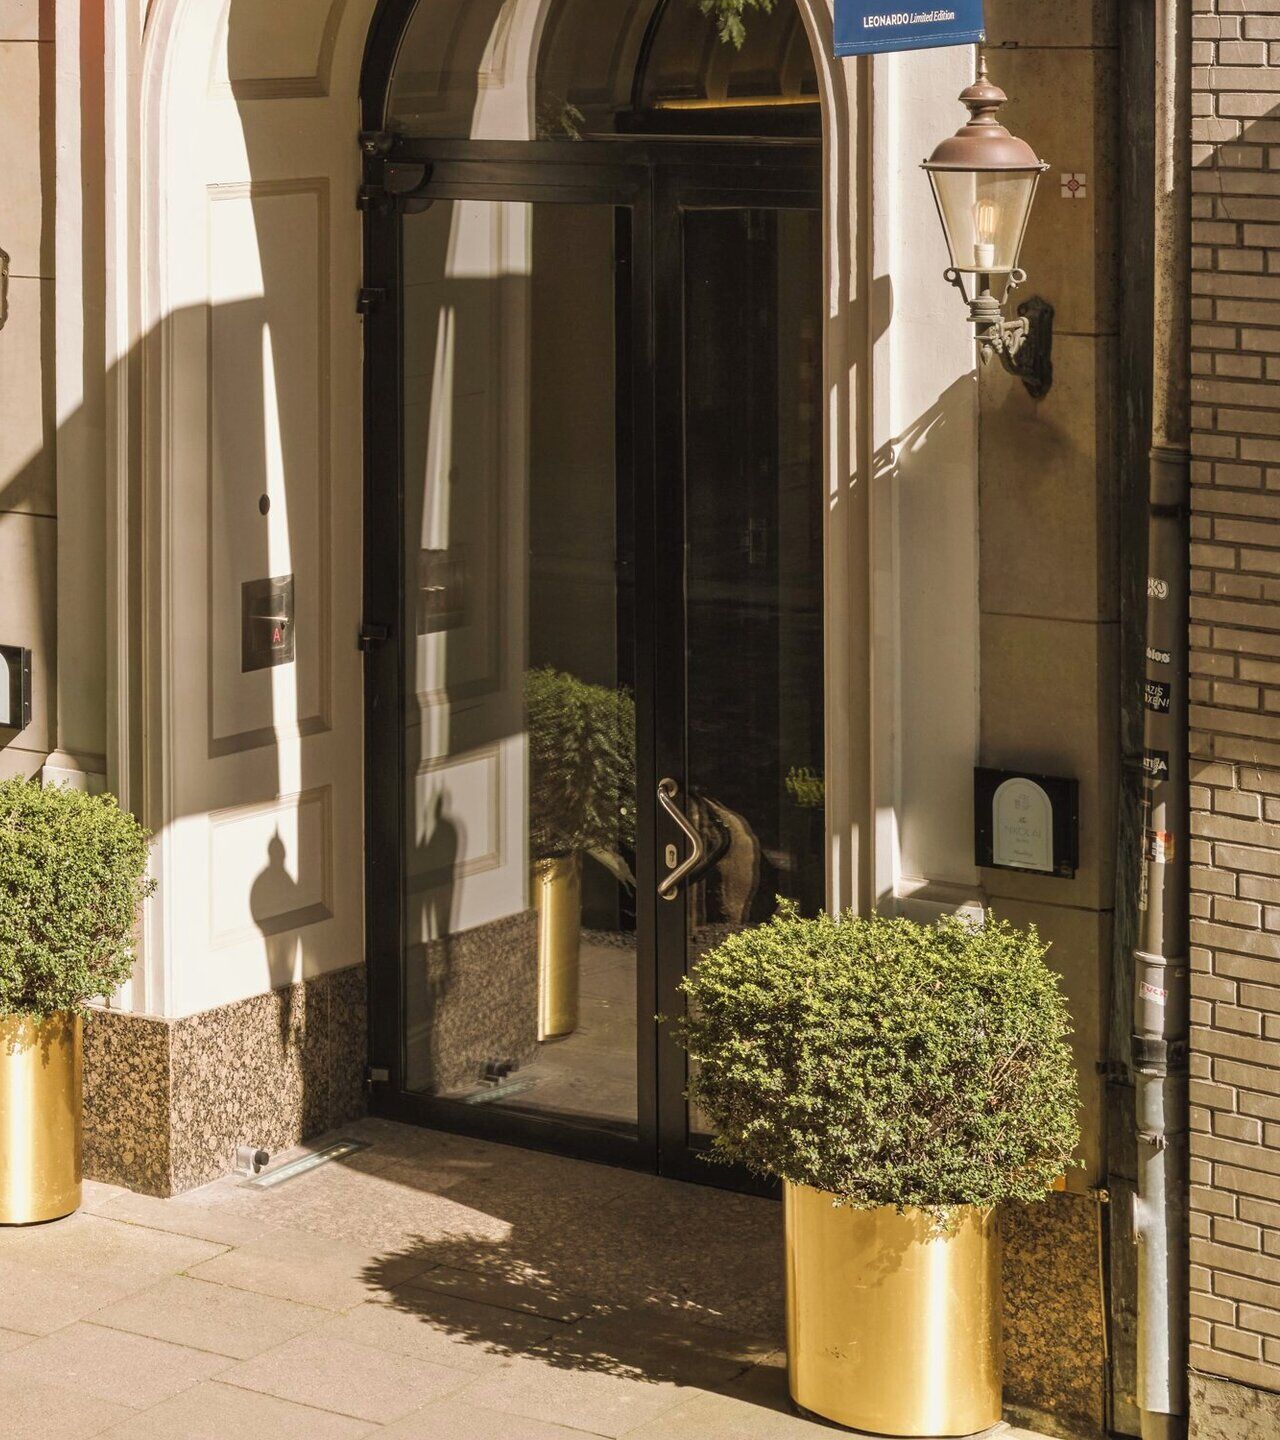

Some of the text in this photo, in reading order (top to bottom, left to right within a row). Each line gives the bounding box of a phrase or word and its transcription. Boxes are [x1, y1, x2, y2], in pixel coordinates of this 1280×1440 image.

[863, 9, 955, 28] LEONARDO Limited Edition
